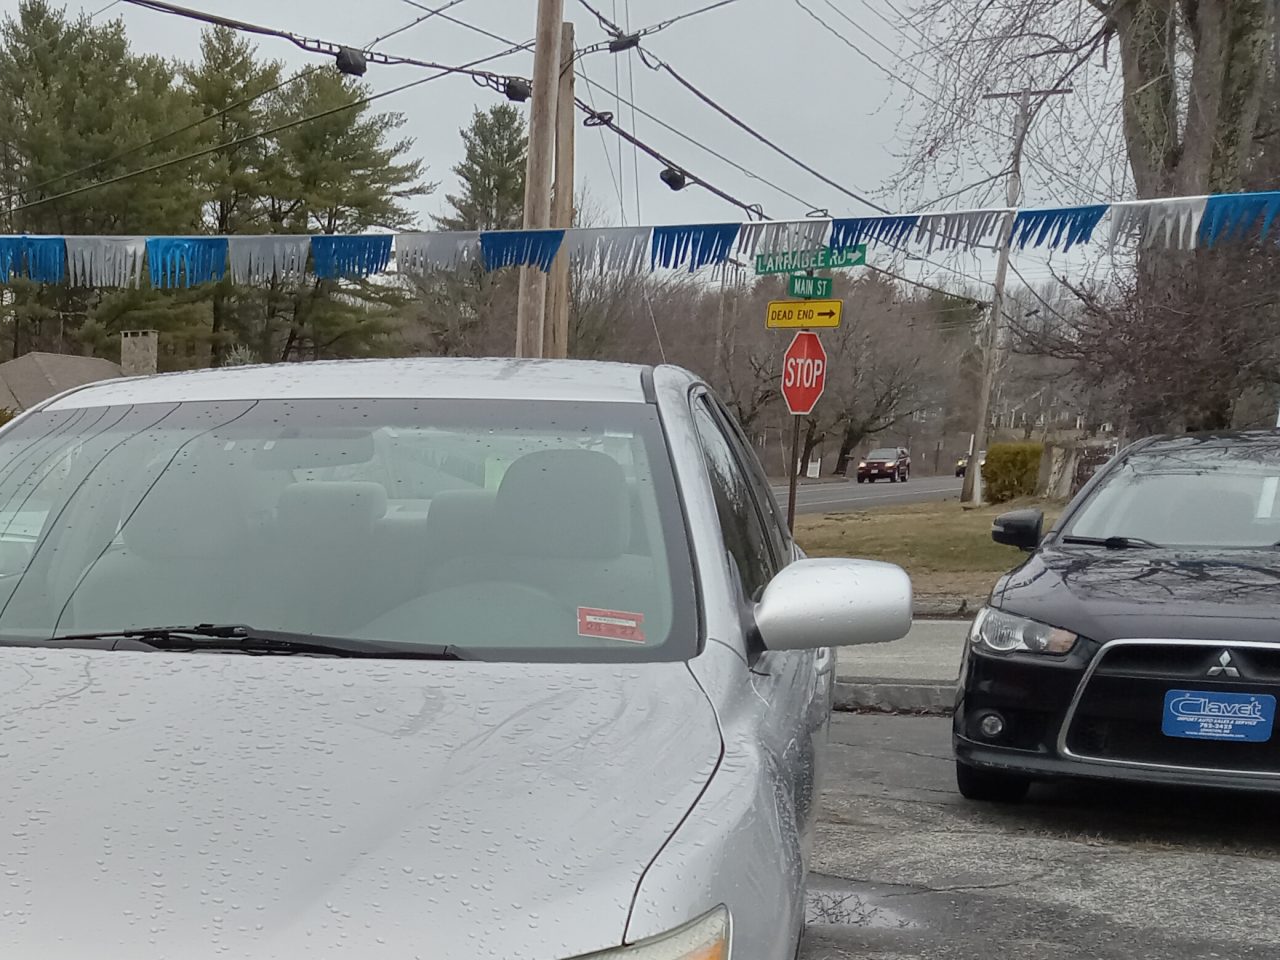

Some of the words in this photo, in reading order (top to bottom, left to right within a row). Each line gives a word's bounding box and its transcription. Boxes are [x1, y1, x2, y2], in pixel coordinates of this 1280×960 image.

[758, 251, 826, 272] LARRABEE
[830, 248, 846, 266] RD
[794, 279, 813, 295] MAIN
[817, 281, 827, 295] ST
[771, 311, 793, 321] DEAD
[797, 310, 814, 320] END
[785, 359, 823, 387] STOP
[1170, 697, 1266, 721] Clavet
